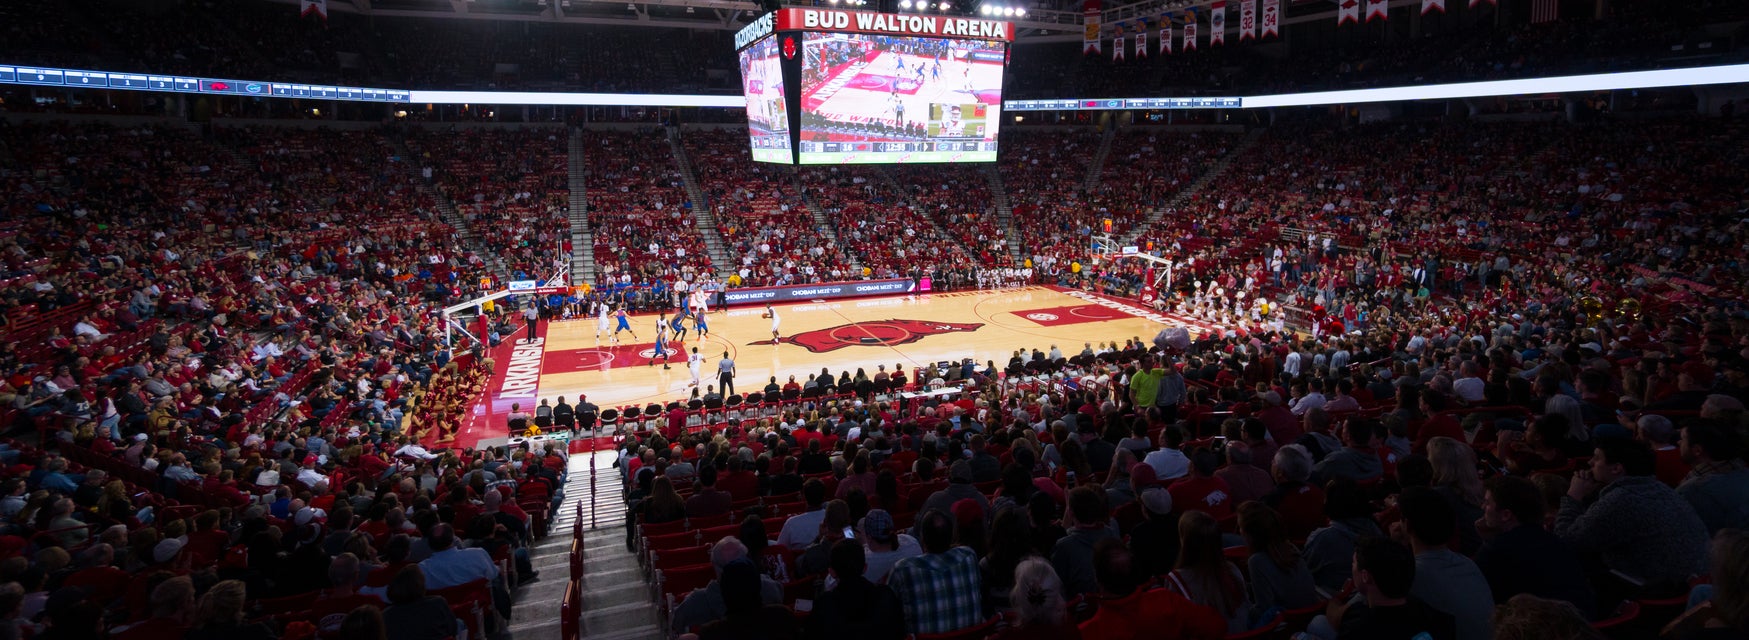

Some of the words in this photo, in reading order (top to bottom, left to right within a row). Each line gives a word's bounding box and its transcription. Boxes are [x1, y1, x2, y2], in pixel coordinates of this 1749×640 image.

[804, 10, 849, 29] BUD
[856, 13, 936, 34] WALTON
[942, 18, 1005, 38] ARENA
[1242, 16, 1253, 30] 32
[1265, 13, 1276, 27] 34
[735, 11, 773, 51] RAZORBACKS
[856, 284, 880, 292] CHOBANI
[500, 336, 545, 398] ARKANSAS
